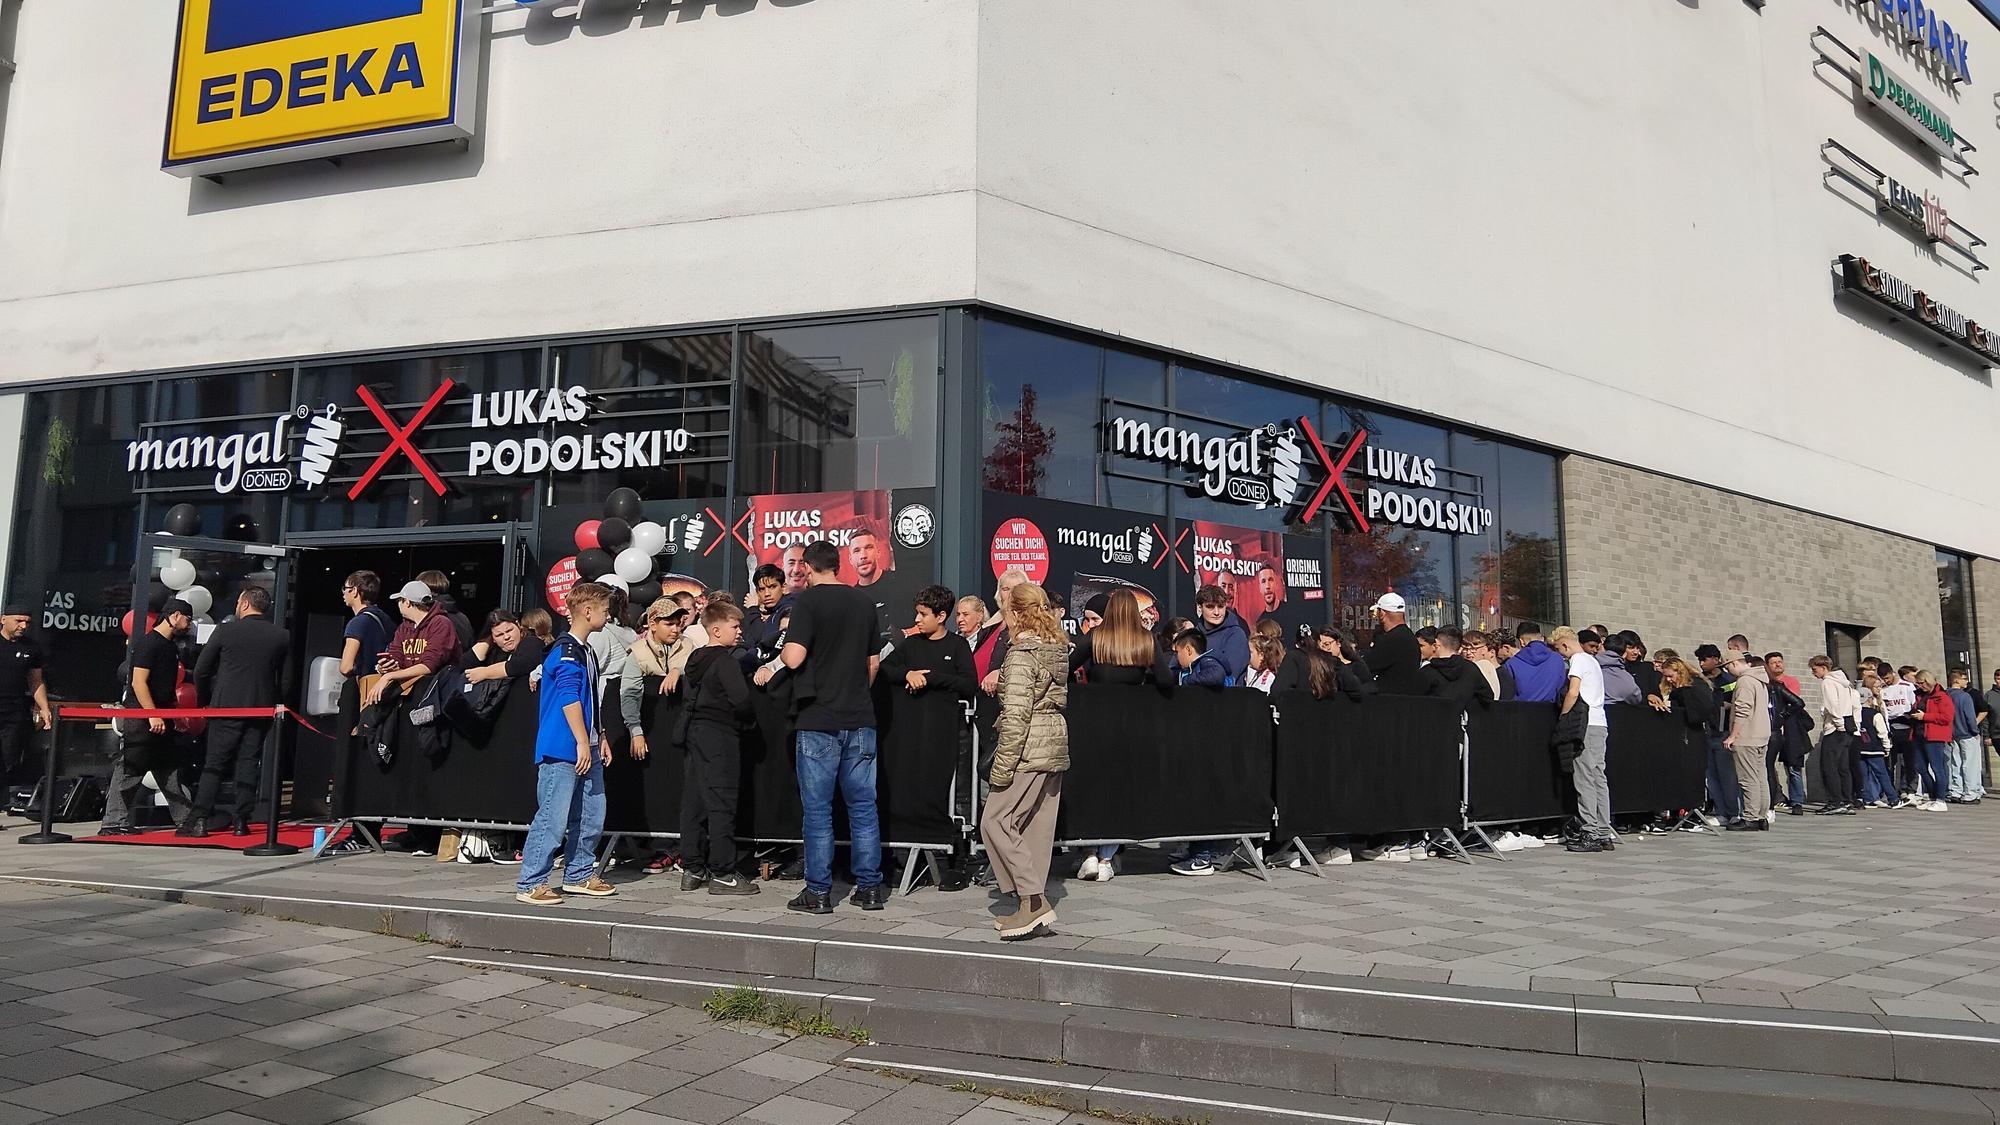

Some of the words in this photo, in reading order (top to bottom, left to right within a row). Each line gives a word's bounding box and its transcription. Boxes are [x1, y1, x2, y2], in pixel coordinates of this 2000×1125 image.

[197, 42, 424, 124] EDEKA
[1886, 77, 1955, 146] DEICHMANN
[1879, 269, 1915, 309] SATURN
[1935, 301, 1967, 338] SATURN
[471, 385, 590, 428] LUKAS
[1367, 446, 1437, 488] LUKAS
[245, 469, 288, 489] DÖNER
[1231, 480, 1267, 501] DÖNER
[764, 509, 821, 529] LUKAS
[1011, 522, 1026, 535] WIR
[995, 537, 1024, 550] SUCHEN
[1024, 537, 1044, 550] DICH!
[1195, 535, 1232, 555] LUKAS
[1286, 558, 1321, 573] ORIGINAL
[549, 571, 575, 585] SUCHEN
[1287, 573, 1321, 588] MANGAL!
